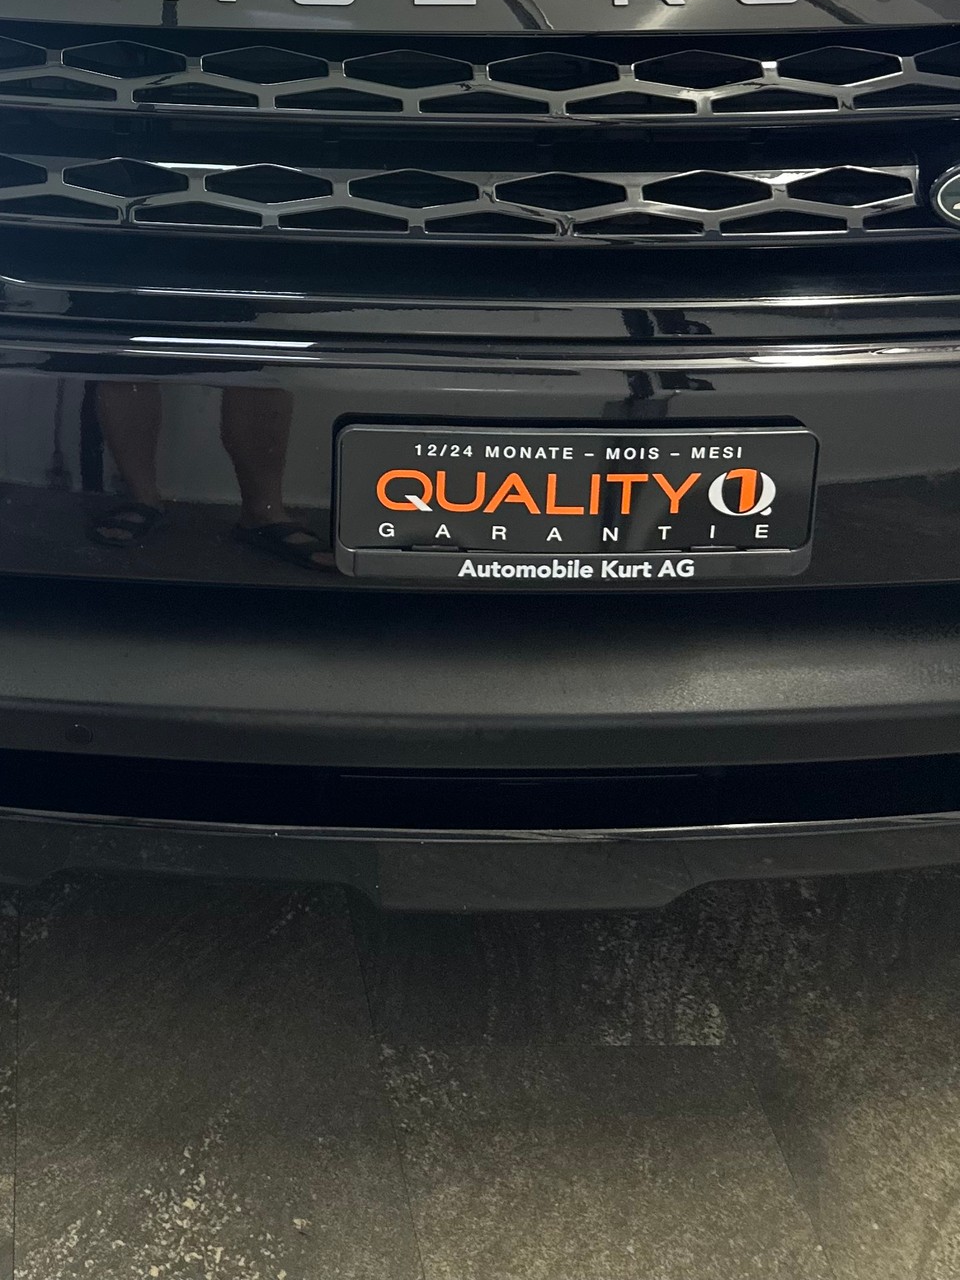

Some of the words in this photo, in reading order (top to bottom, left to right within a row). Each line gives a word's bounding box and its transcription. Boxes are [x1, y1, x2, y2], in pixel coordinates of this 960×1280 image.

[414, 443, 474, 458] 12/24
[484, 445, 574, 460] MONATE
[605, 447, 660, 460] MOIS
[690, 446, 743, 460] MESI
[376, 469, 702, 515] QUALITY
[378, 522, 770, 543] GARANTIE
[457, 559, 594, 579] Automobile
[601, 560, 653, 579] Kurt
[657, 559, 696, 578] AG
